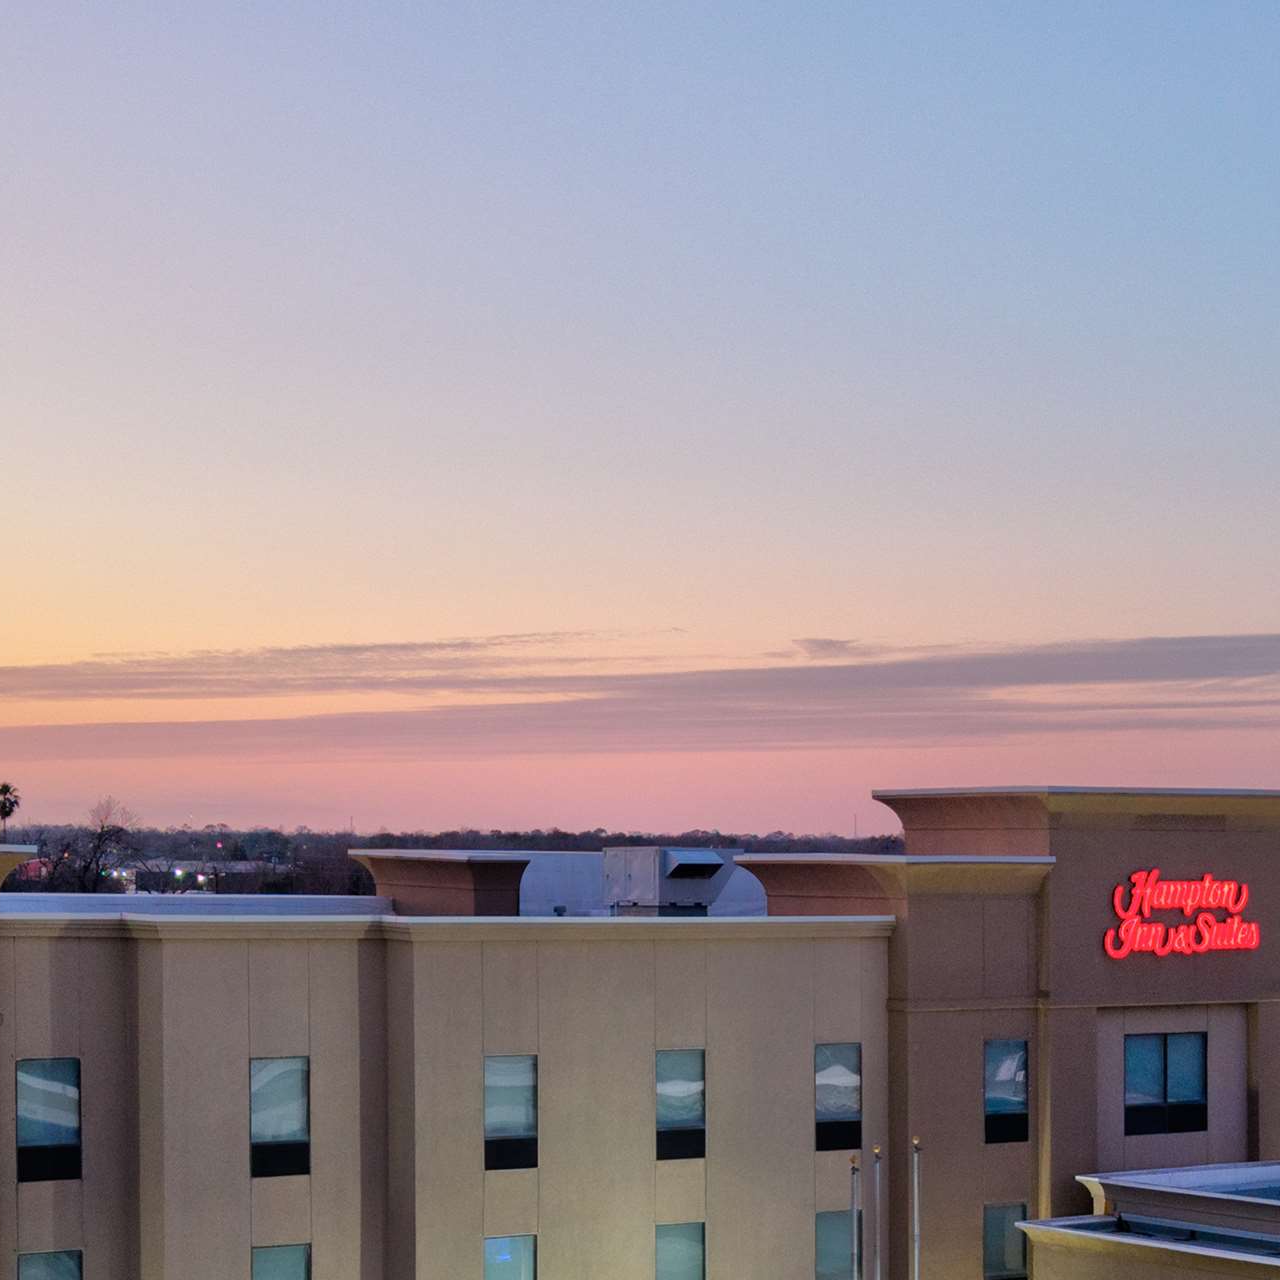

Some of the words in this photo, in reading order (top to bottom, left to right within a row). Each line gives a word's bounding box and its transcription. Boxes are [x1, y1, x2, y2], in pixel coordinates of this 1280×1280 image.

[1113, 868, 1249, 919] Hampton
[1104, 914, 1174, 959] Inn
[1191, 912, 1261, 953] Suites
